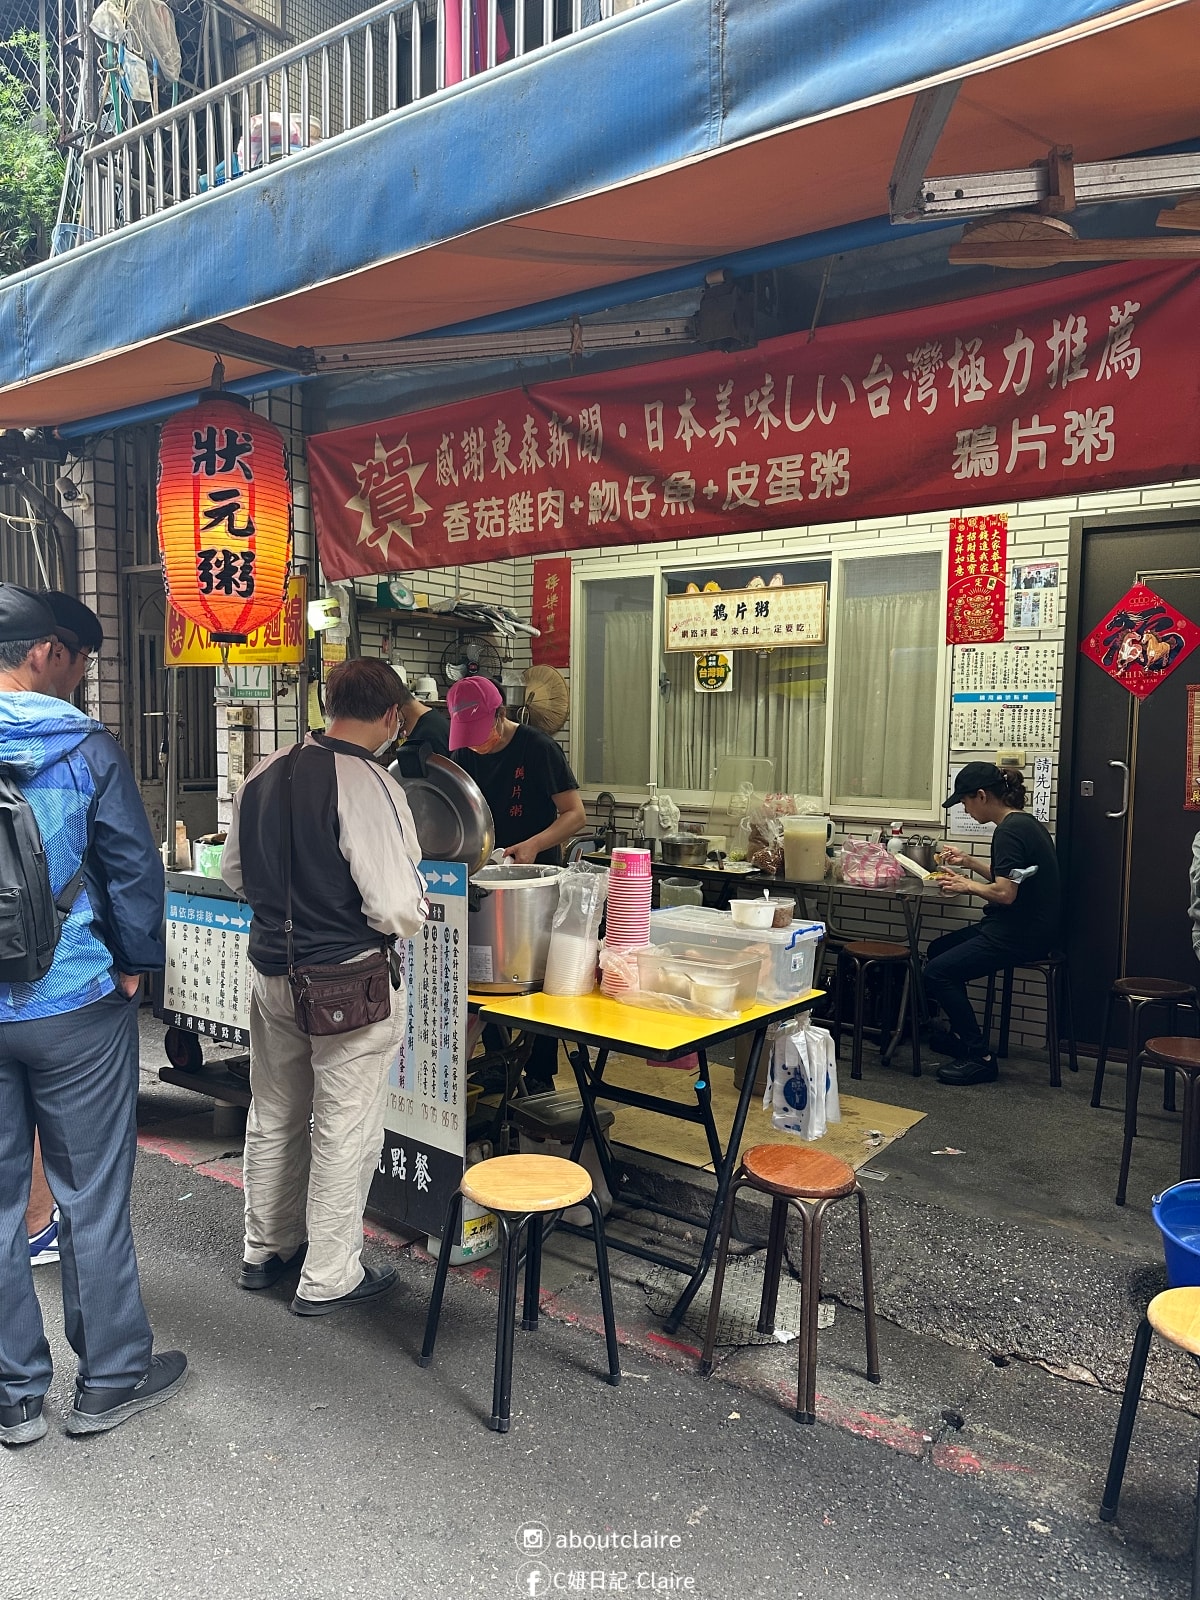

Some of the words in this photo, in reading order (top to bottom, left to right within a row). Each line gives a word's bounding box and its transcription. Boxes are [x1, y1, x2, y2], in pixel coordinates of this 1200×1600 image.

[951, 405, 1115, 480] 鴉片粥
[191, 426, 255, 598] 狀元粥
[357, 445, 426, 548] 賀
[1034, 757, 1051, 822] 請先付款
